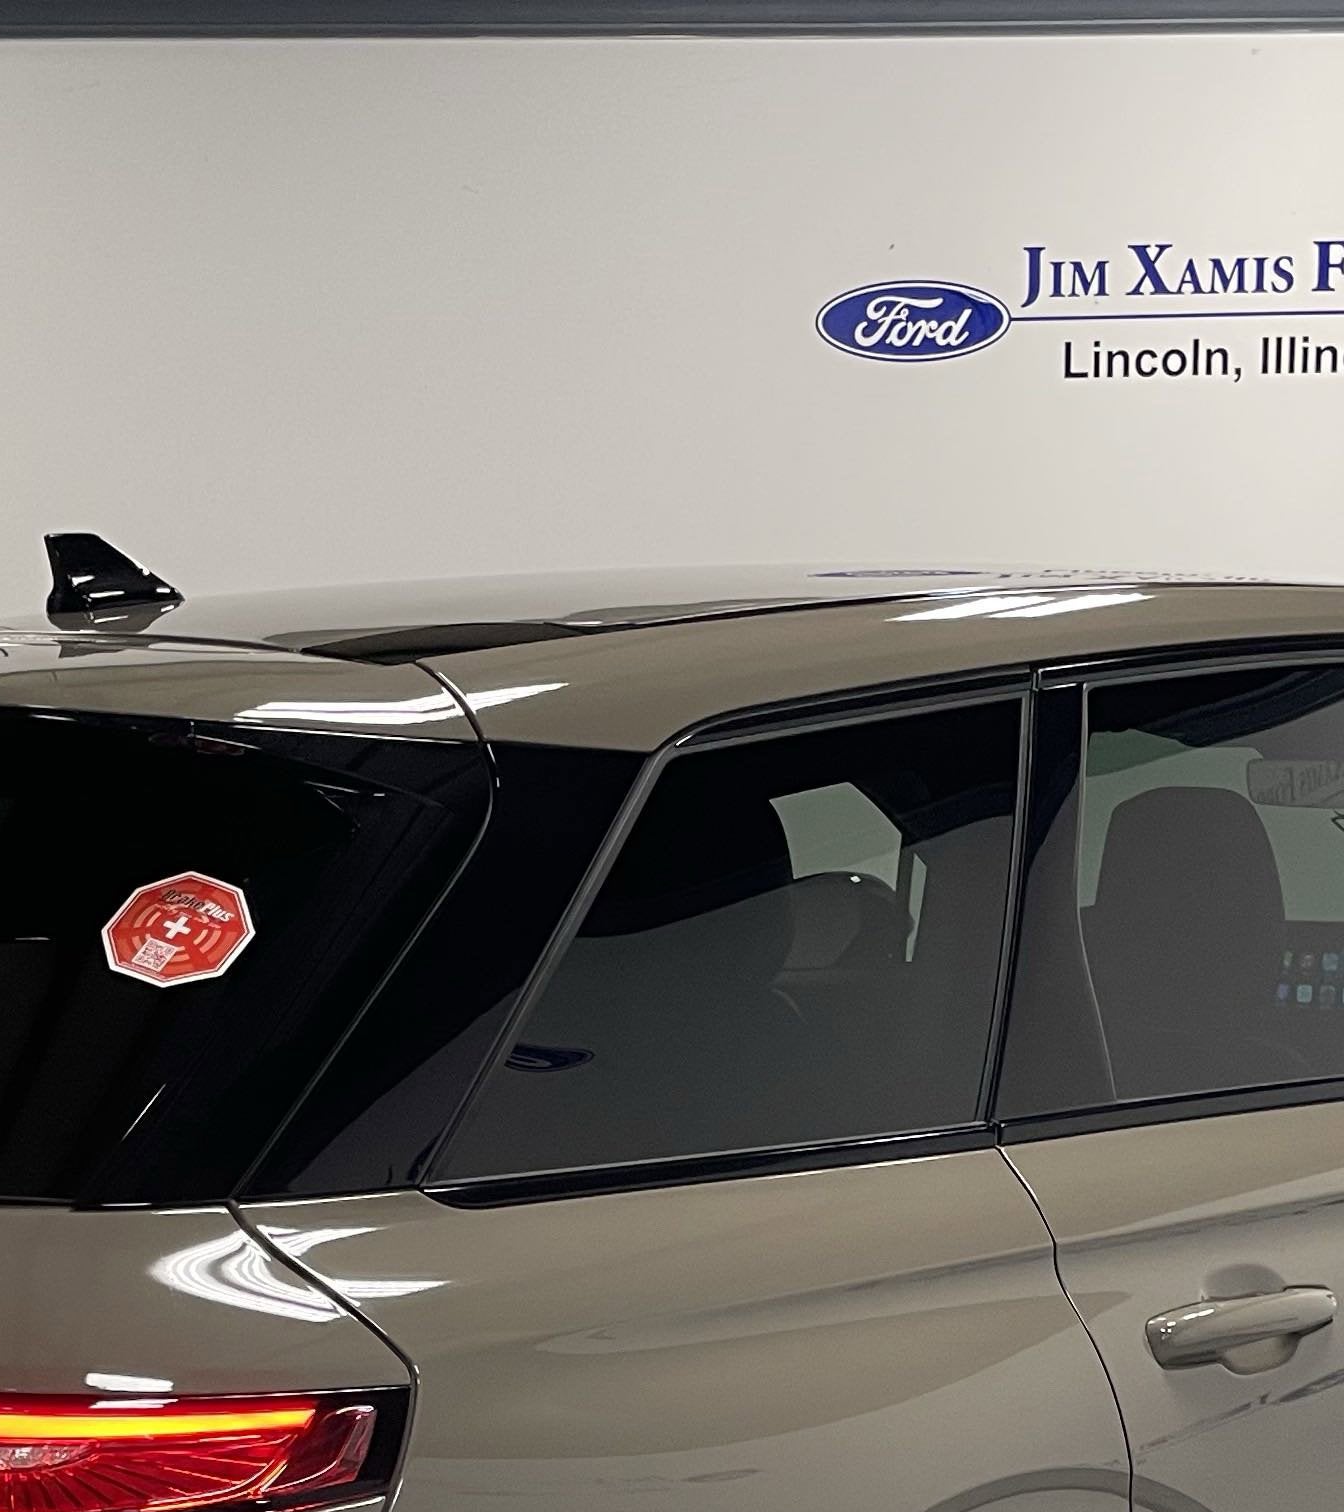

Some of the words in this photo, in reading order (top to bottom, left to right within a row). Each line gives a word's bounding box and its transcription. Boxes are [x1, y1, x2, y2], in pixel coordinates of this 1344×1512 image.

[1021, 246, 1109, 308] JIM
[1125, 244, 1294, 296] XAMIS
[854, 295, 971, 350] Ford
[1064, 339, 1242, 383] Lincoln,
